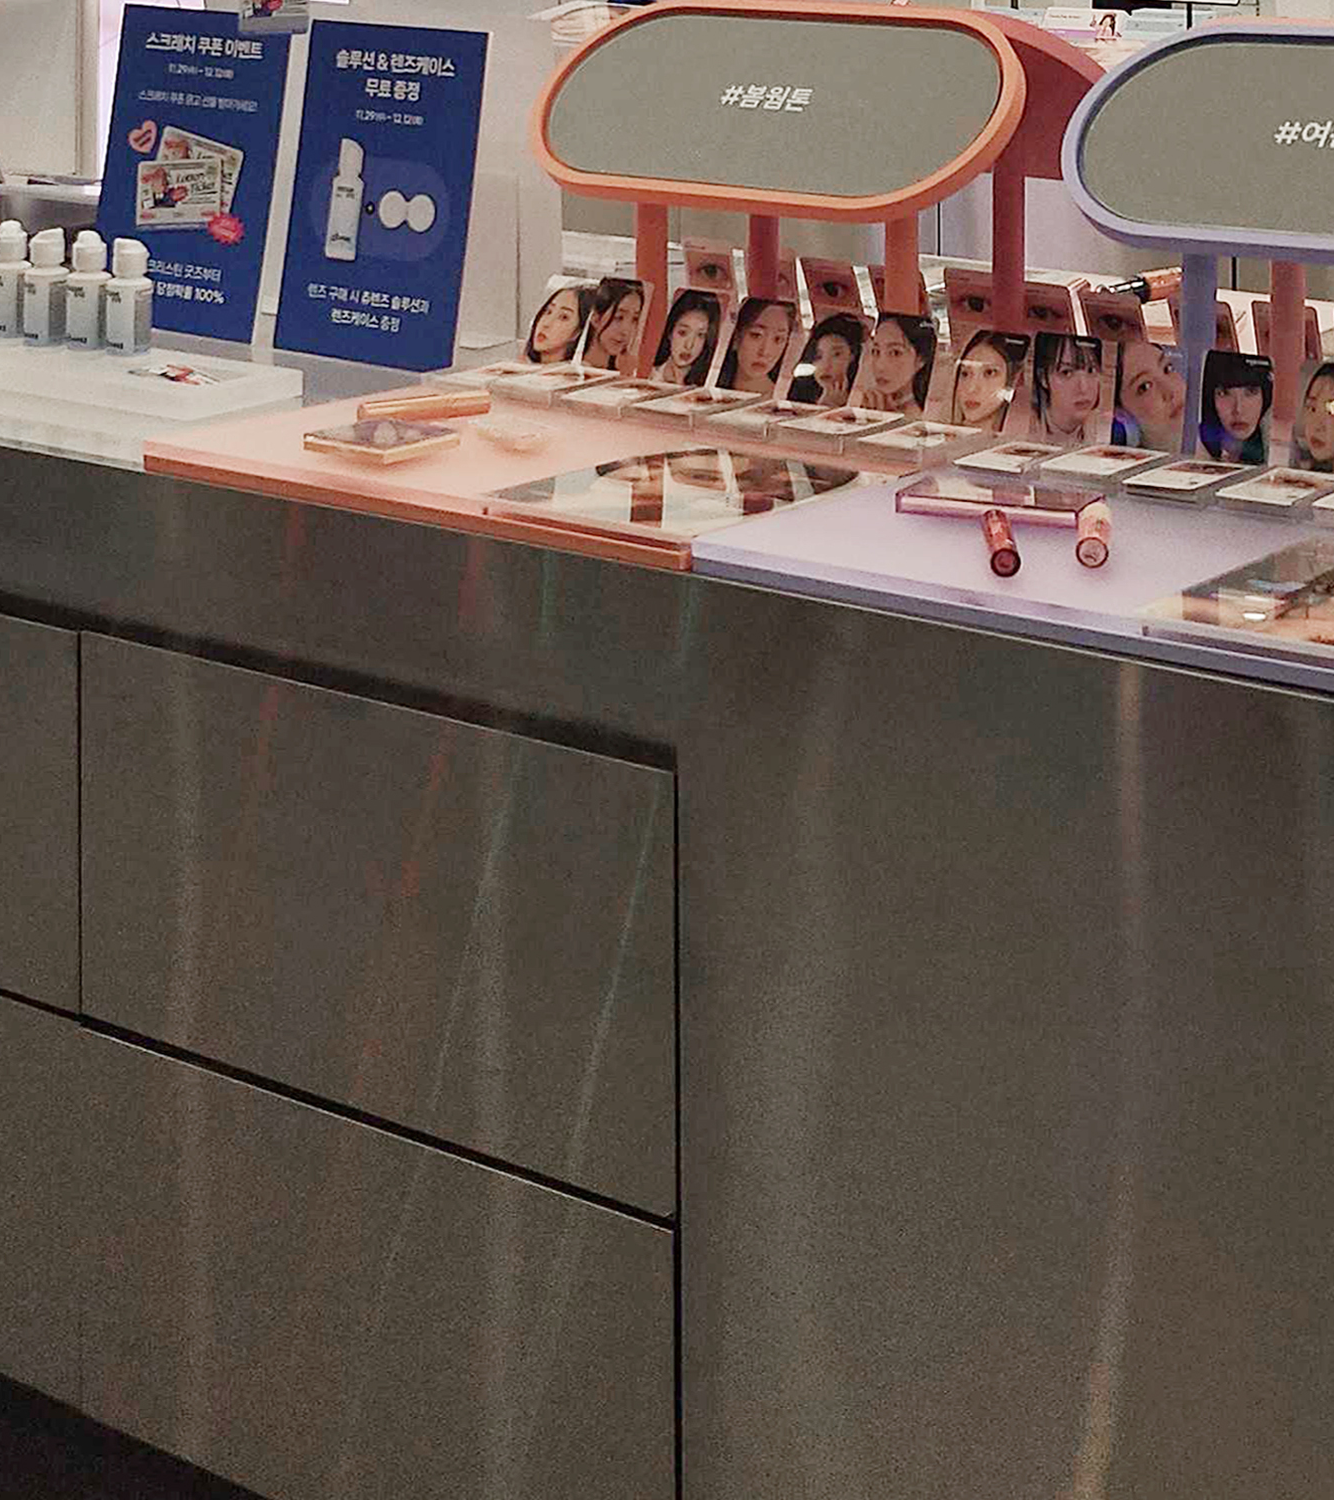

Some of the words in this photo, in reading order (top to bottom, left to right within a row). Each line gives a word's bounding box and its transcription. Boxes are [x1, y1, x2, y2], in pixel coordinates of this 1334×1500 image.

[198, 36, 224, 56] 쿠폰
[225, 39, 264, 59] 이벤트
[336, 49, 375, 70] 솔루션
[377, 53, 388, 71] &
[390, 53, 455, 77] 렌즈케이스
[365, 78, 392, 98] 무료
[393, 80, 421, 101] 증정
[721, 84, 813, 112] #봄웜톤
[184, 264, 222, 282] 굿즈부터
[195, 287, 225, 305] 100%
[308, 283, 327, 298] 렌즈
[328, 286, 348, 301] 구매
[349, 289, 360, 303] 시
[331, 308, 379, 329] 렌즈케이스
[380, 315, 401, 332] 증정
